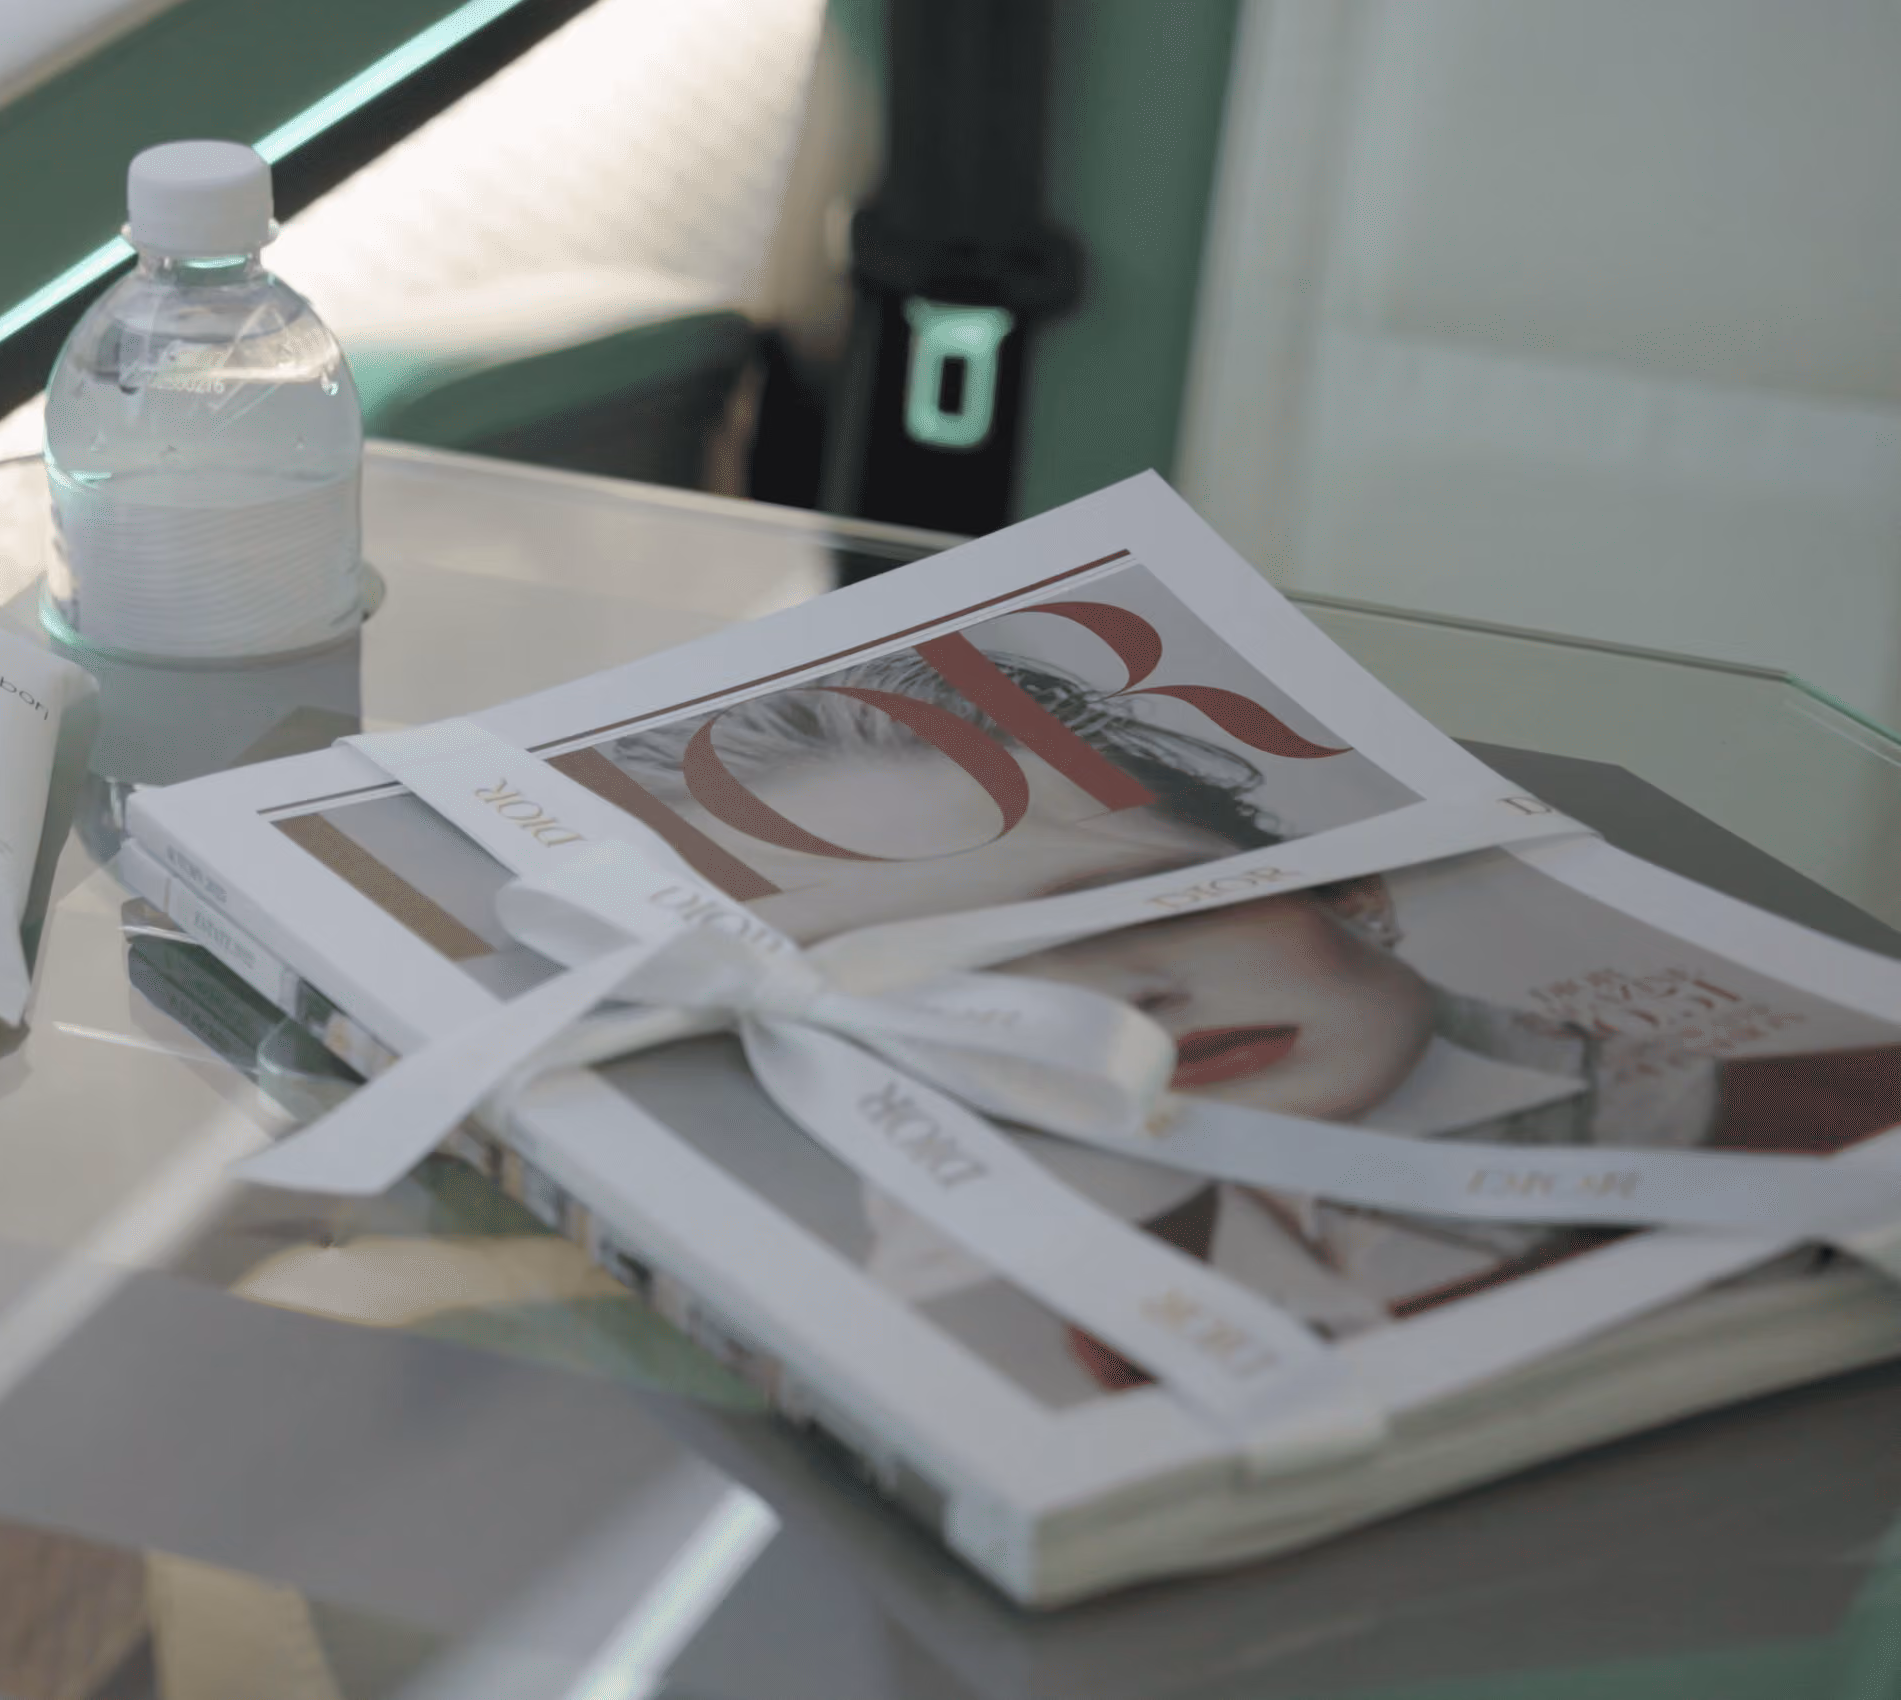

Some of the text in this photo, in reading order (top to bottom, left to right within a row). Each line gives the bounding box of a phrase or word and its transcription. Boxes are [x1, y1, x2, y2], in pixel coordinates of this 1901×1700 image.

[475, 777, 589, 848] DIOR
[1147, 866, 1301, 911] DIOR
[856, 1082, 989, 1189] DIOR
